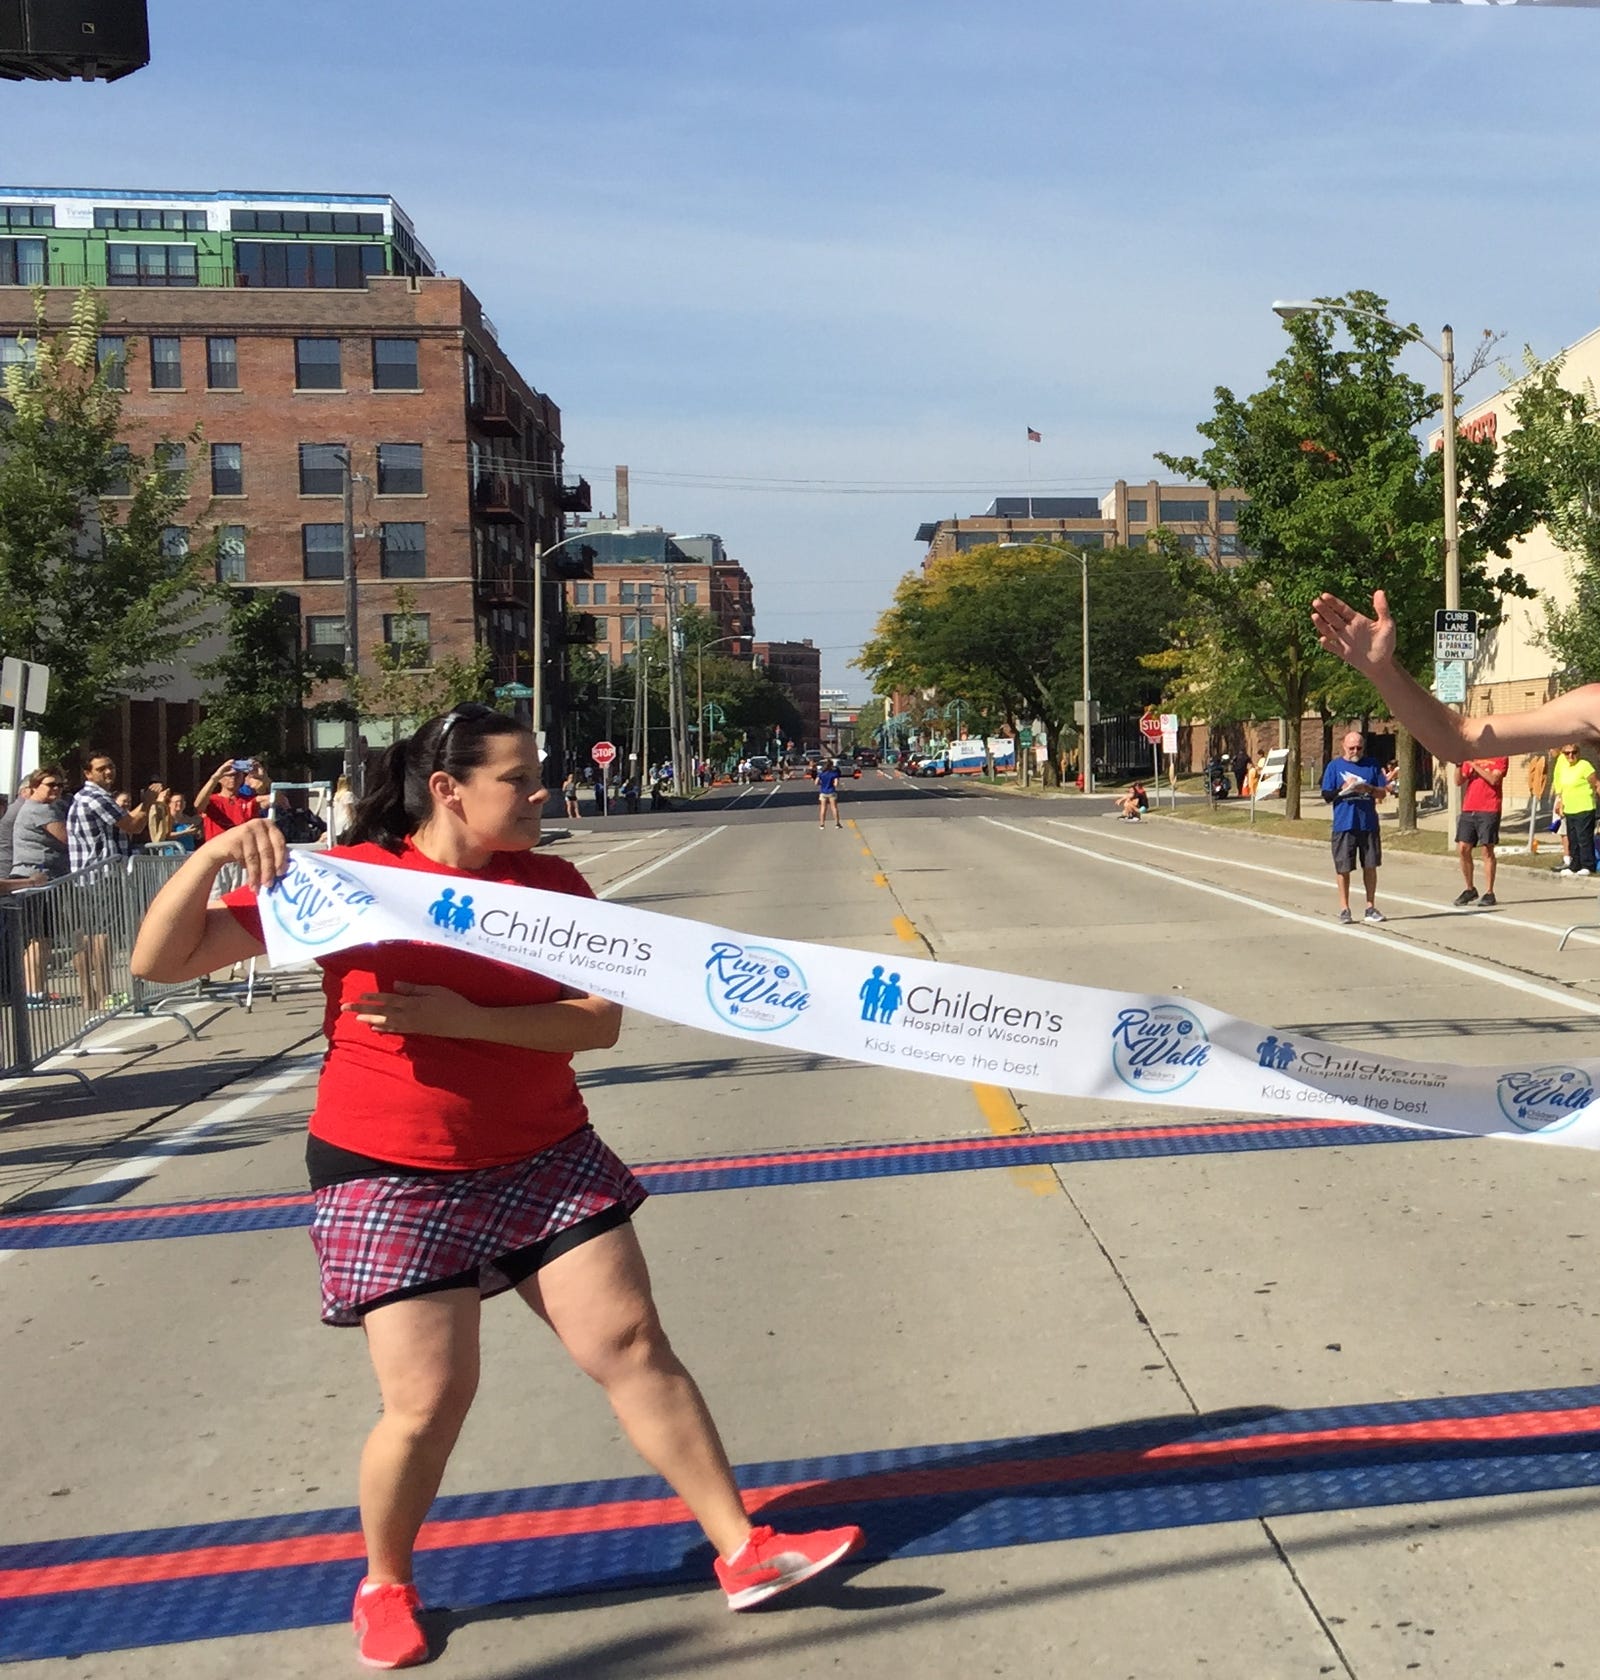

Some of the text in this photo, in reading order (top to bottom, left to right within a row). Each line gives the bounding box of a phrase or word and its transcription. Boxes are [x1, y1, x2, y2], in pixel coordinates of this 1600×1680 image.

[1445, 612, 1469, 621] CURB
[1445, 623, 1468, 632] LANE
[1438, 633, 1473, 641] BICYCLES
[1445, 642, 1473, 650] PARKING
[1444, 650, 1466, 658] ONLY
[1142, 719, 1161, 730] STO
[593, 748, 614, 758] STOP
[480, 909, 653, 962] Children's
[478, 935, 544, 959] Hospital
[547, 950, 565, 963] of
[569, 952, 648, 977] Wisconsin
[705, 941, 771, 985] Run
[723, 973, 811, 1012] Walk
[907, 986, 1064, 1033] Children's
[902, 1016, 1059, 1048] Hospital of Wisconsin
[1112, 1008, 1174, 1051] Run
[864, 1036, 1040, 1076] Kids deserve the best.
[1128, 1037, 1211, 1067] Walk
[1300, 1051, 1448, 1081] Children's
[1298, 1065, 1446, 1088] Hospital of Wisconsin
[1261, 1084, 1429, 1114] Kids deserve the best.
[1512, 1085, 1594, 1109] Walk
